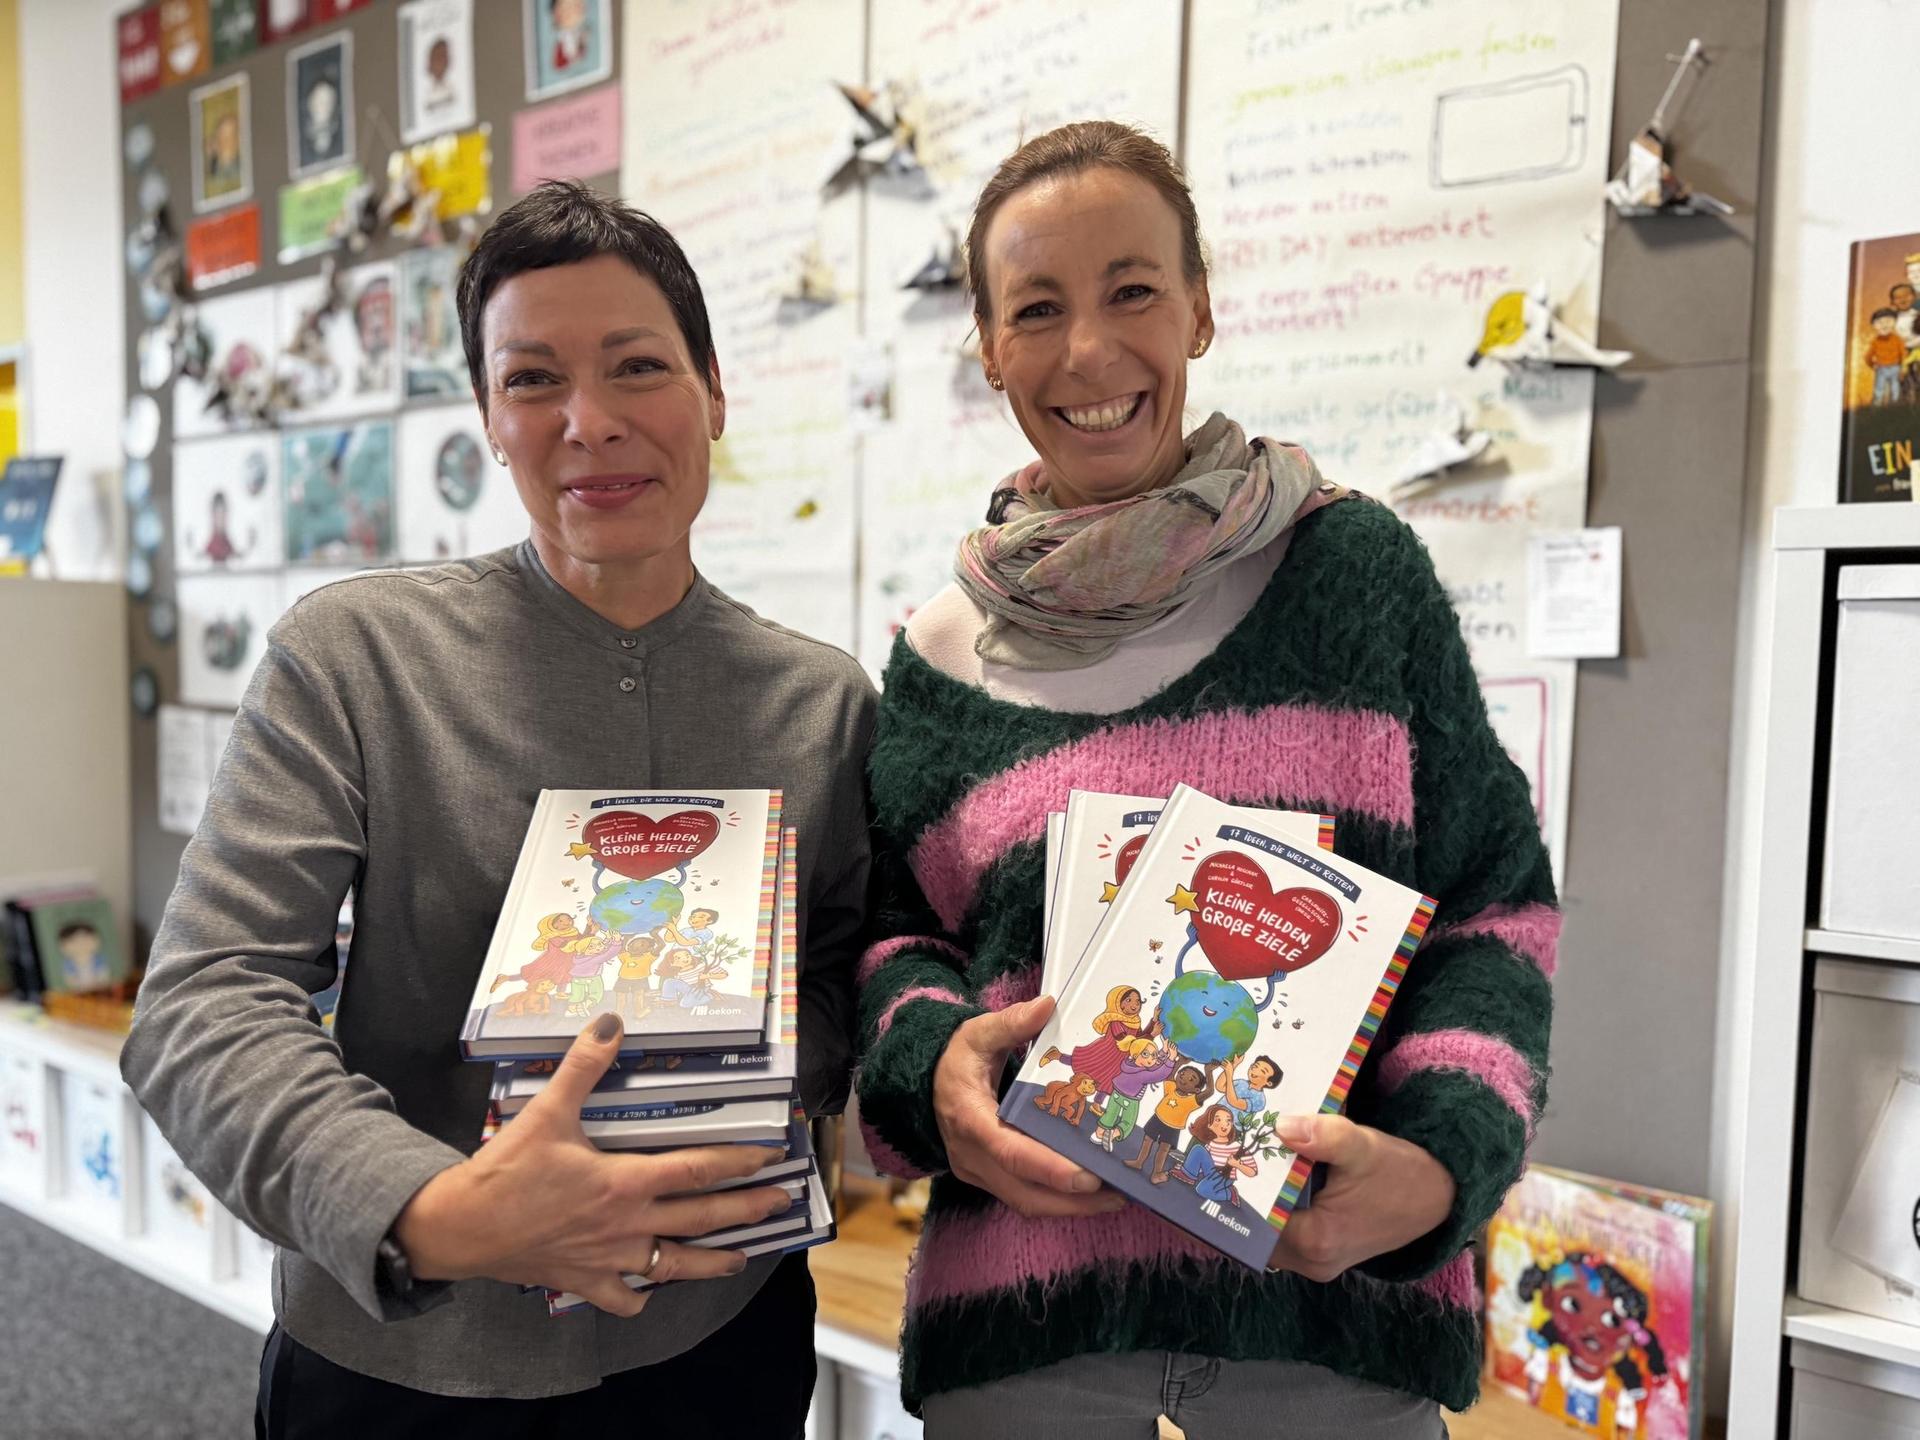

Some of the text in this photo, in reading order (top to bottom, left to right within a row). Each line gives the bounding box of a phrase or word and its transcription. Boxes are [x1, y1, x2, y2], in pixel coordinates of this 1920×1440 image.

[1868, 439, 1913, 476] EIN
[650, 832, 701, 844] HELDEN,
[654, 843, 697, 854] ZIELE
[1230, 828, 1241, 838] 17
[1270, 844, 1284, 854] DIE
[1287, 850, 1310, 866] WELT
[1310, 862, 1323, 873] ZU
[1322, 869, 1355, 892] RETTEN
[1256, 907, 1312, 950] HELDEN,
[1254, 929, 1302, 962] ZIELE
[708, 1006, 742, 1016] oekom
[740, 1054, 773, 1064] oekom
[1218, 1214, 1251, 1238] oekom
